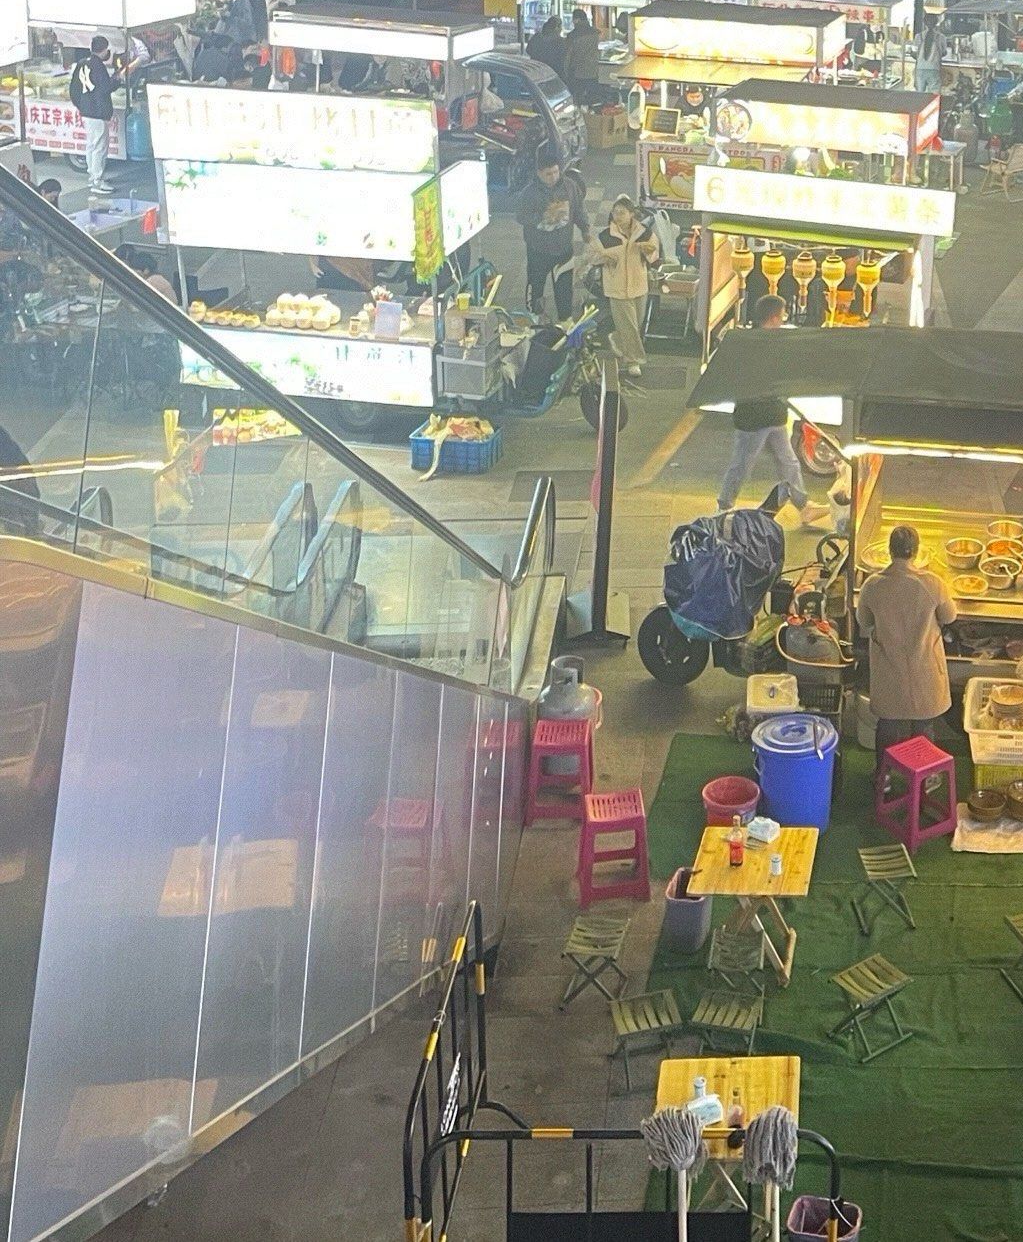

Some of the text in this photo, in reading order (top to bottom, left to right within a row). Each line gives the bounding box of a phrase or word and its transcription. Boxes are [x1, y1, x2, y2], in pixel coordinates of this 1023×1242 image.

[25, 104, 86, 130] 庆正宗米线
